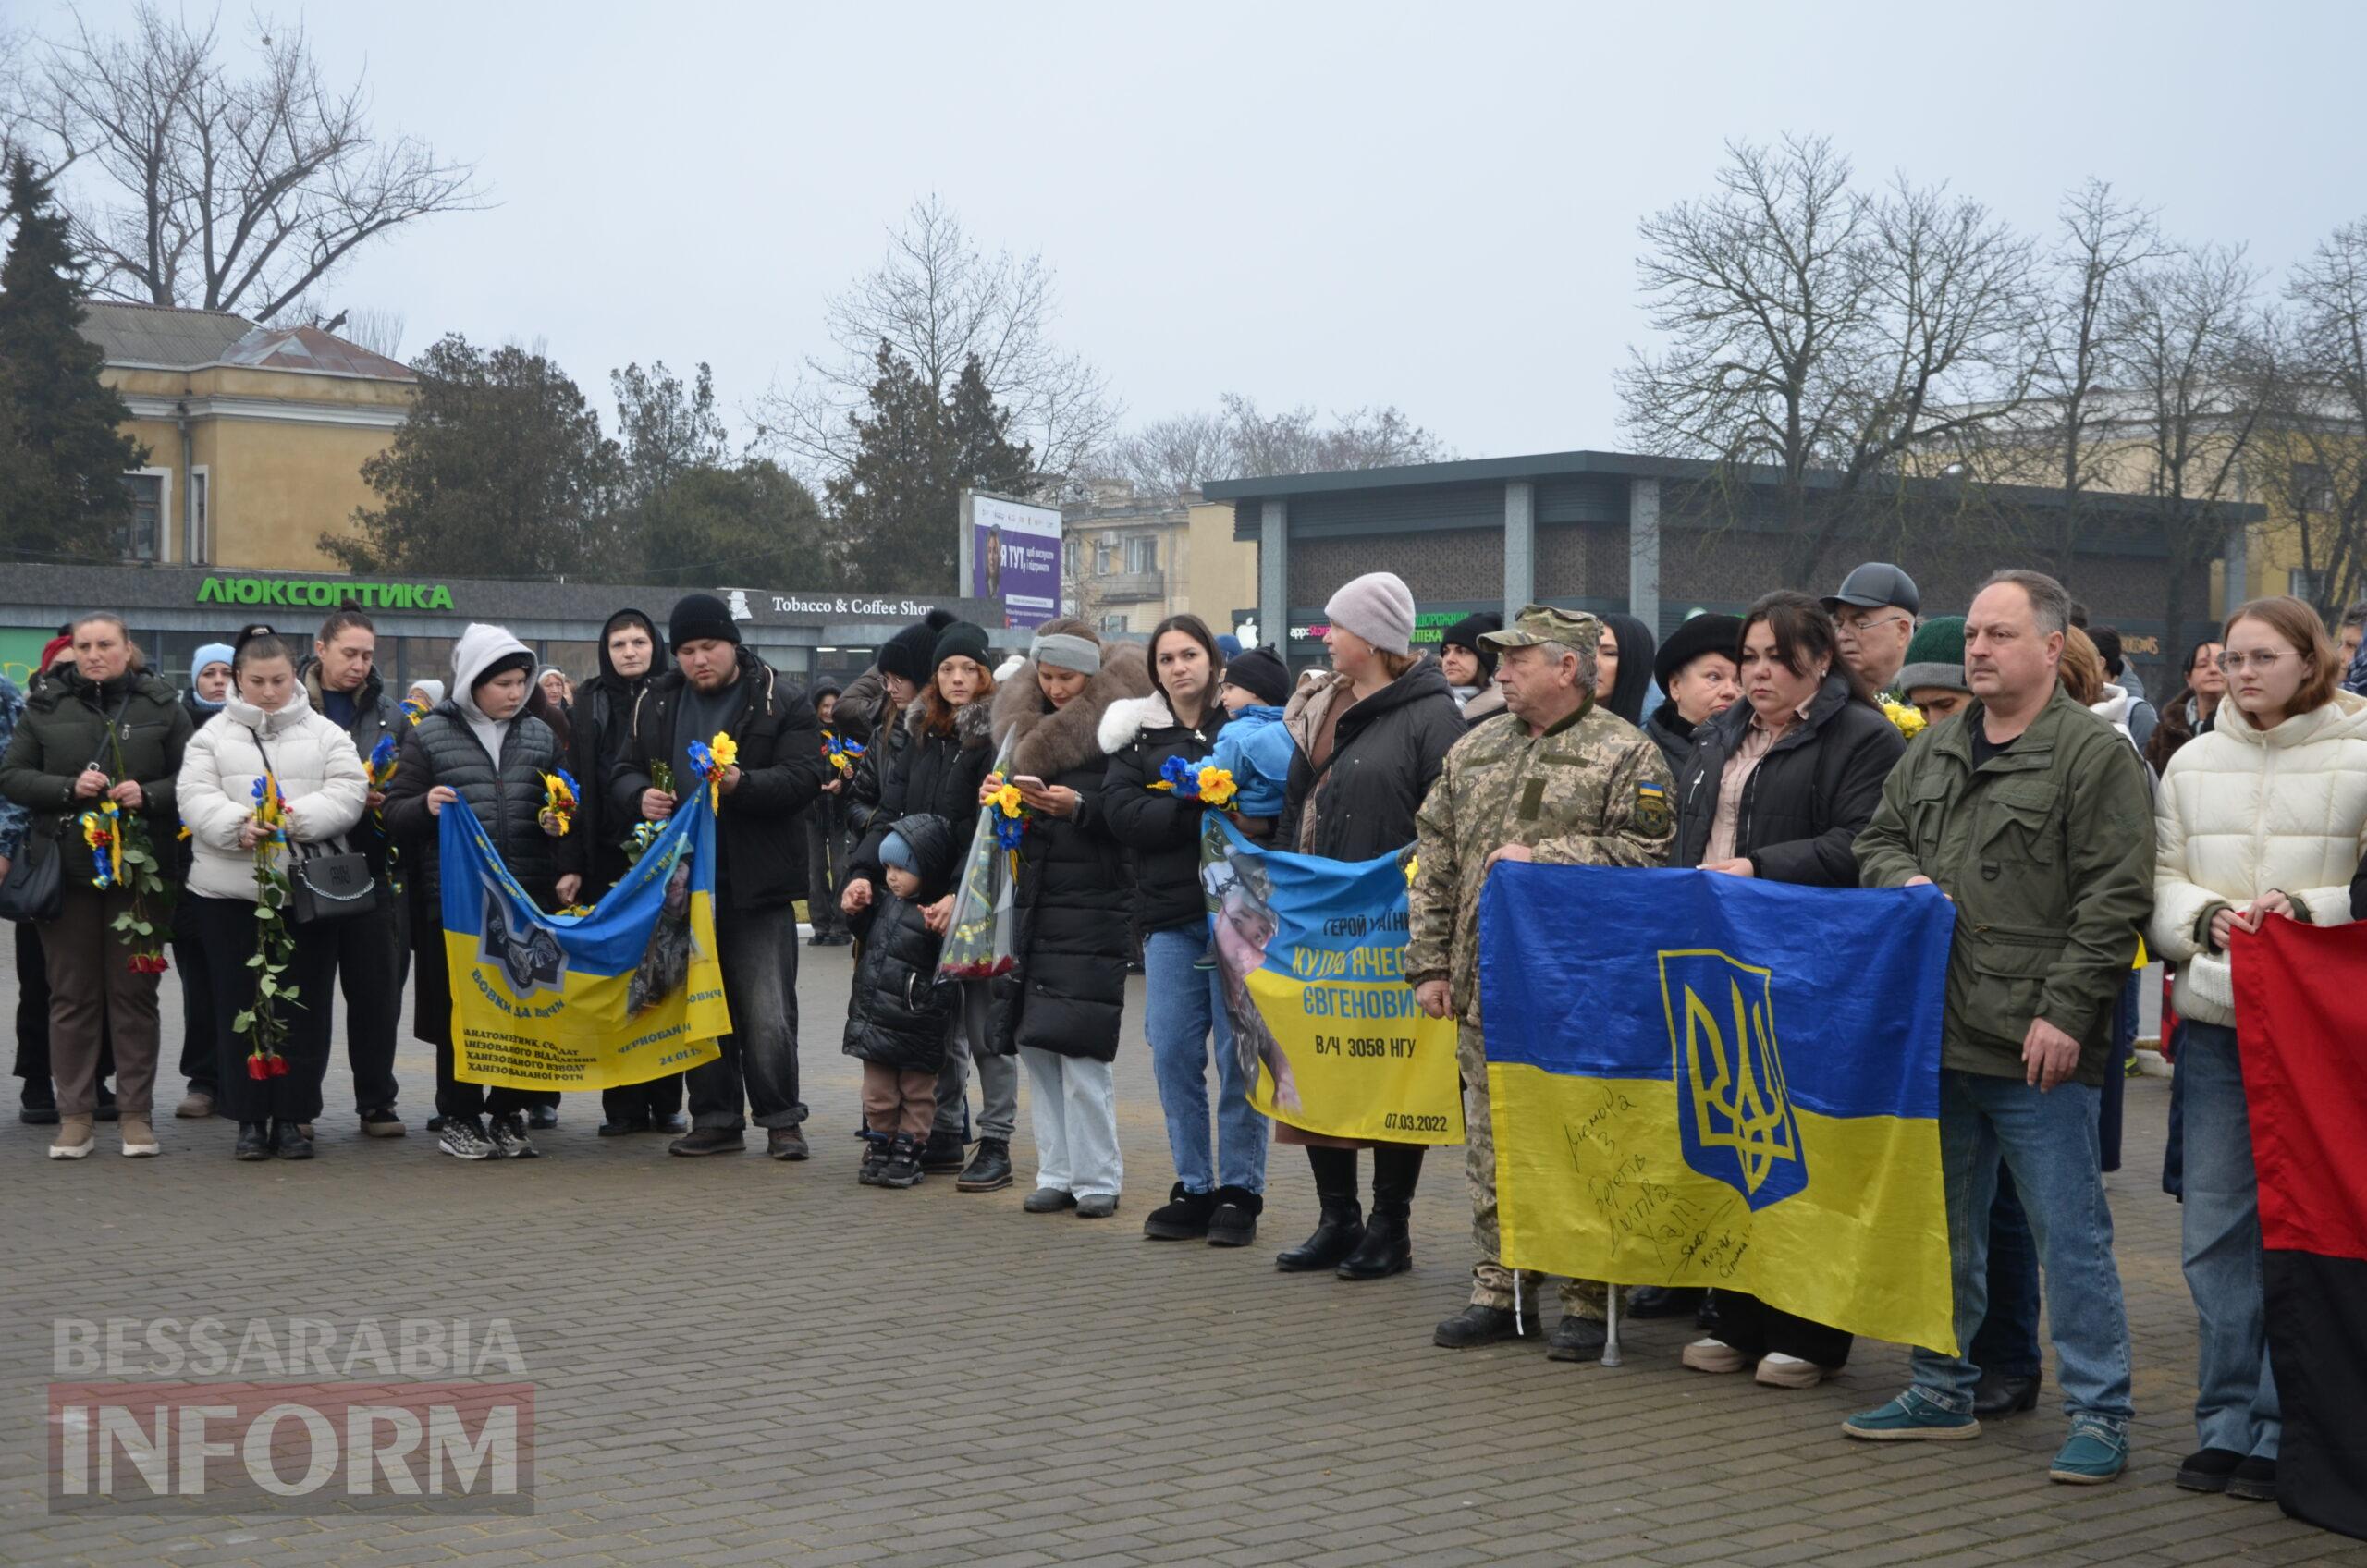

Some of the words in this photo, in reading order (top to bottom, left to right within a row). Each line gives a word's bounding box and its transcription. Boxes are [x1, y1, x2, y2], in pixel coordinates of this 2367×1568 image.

[1000, 545, 1007, 567] Я
[1008, 545, 1025, 573] ТУТ,
[196, 577, 455, 609] ЛЮКСОПТИКА
[772, 596, 832, 613] Tobacco
[835, 598, 847, 613] &
[851, 599, 897, 615] Coffee
[1323, 913, 1367, 937] ГЕРОЙ
[1316, 1035, 1341, 1056] В/Ч
[1348, 1037, 1385, 1057] 3058
[1390, 1038, 1416, 1058] НГУ
[1384, 1112, 1448, 1132] 07.03.2022
